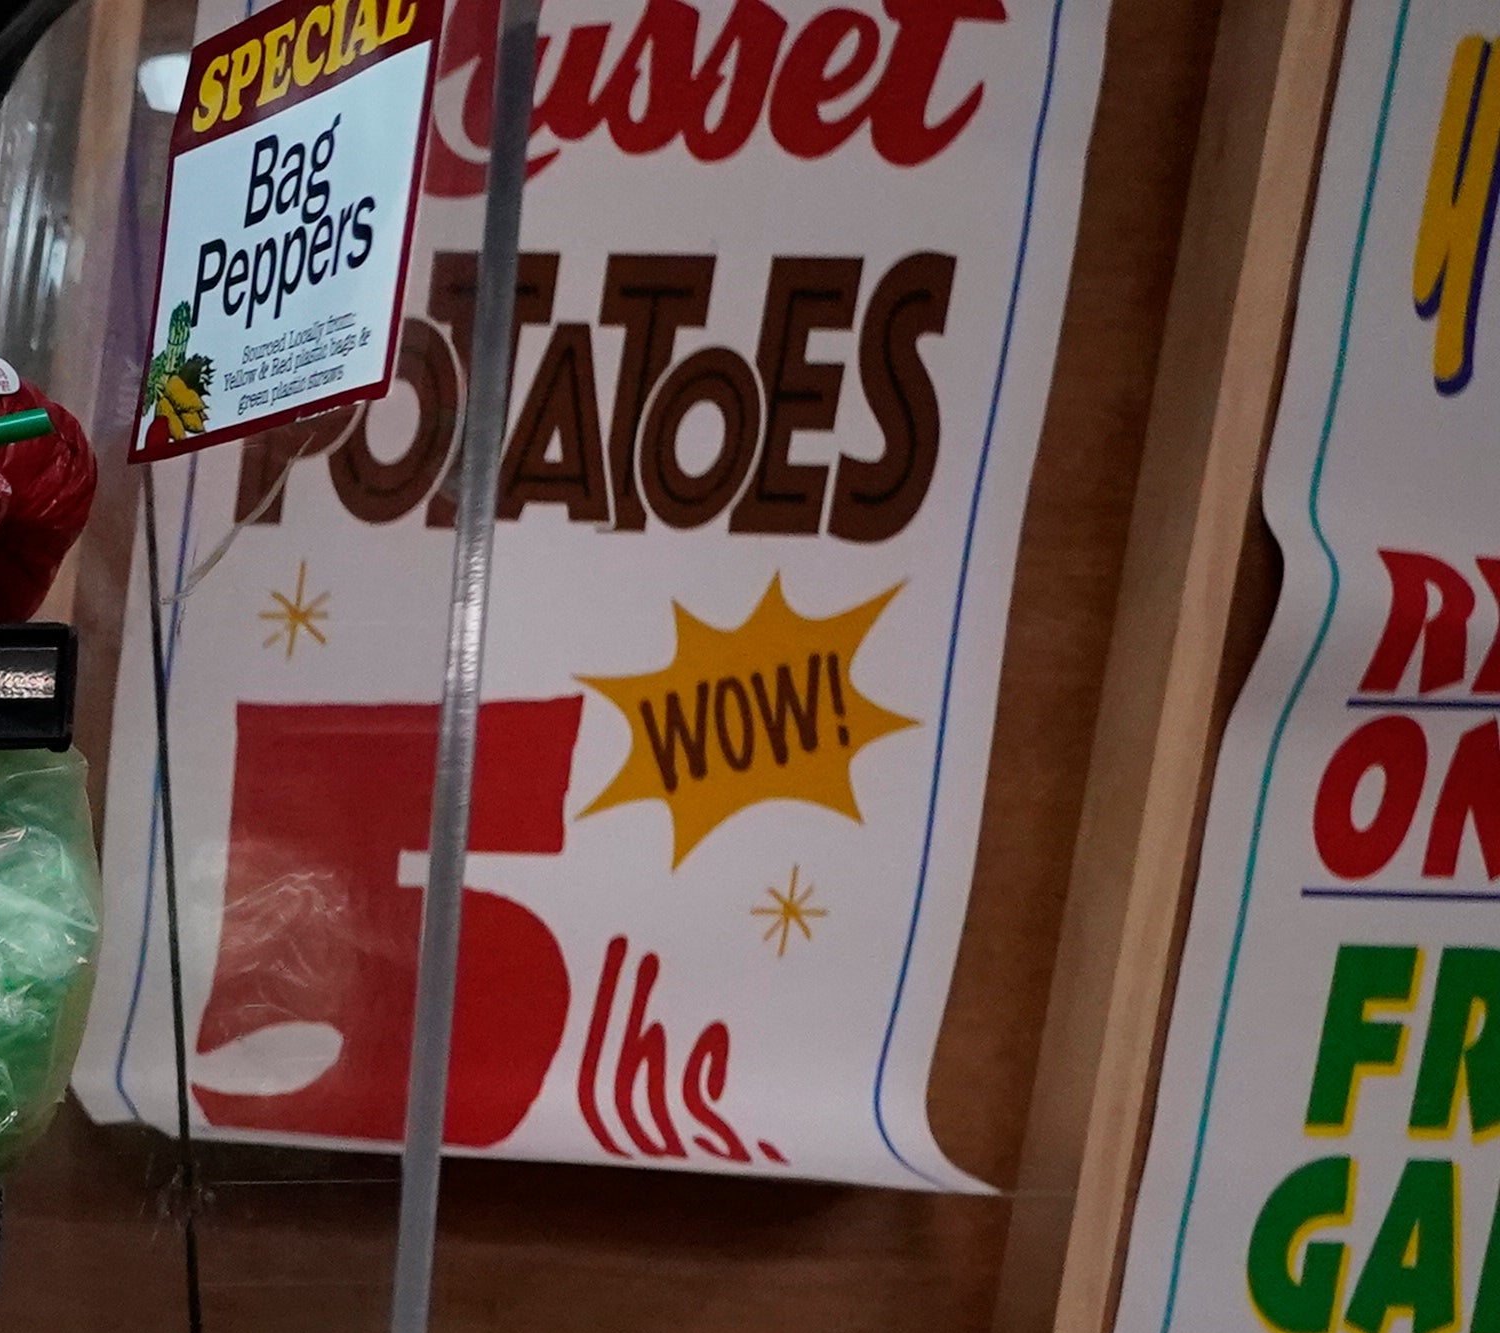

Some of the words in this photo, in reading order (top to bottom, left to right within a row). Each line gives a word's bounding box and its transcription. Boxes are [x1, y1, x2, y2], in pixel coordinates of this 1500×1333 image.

[192, 0, 416, 132] SPECIAL
[243, 113, 341, 228] Bag
[191, 195, 376, 328] Peppers
[235, 250, 958, 545] OTATOES
[640, 655, 845, 795] WOW!
[190, 693, 585, 1148] 5
[575, 937, 792, 1166] lbs.
